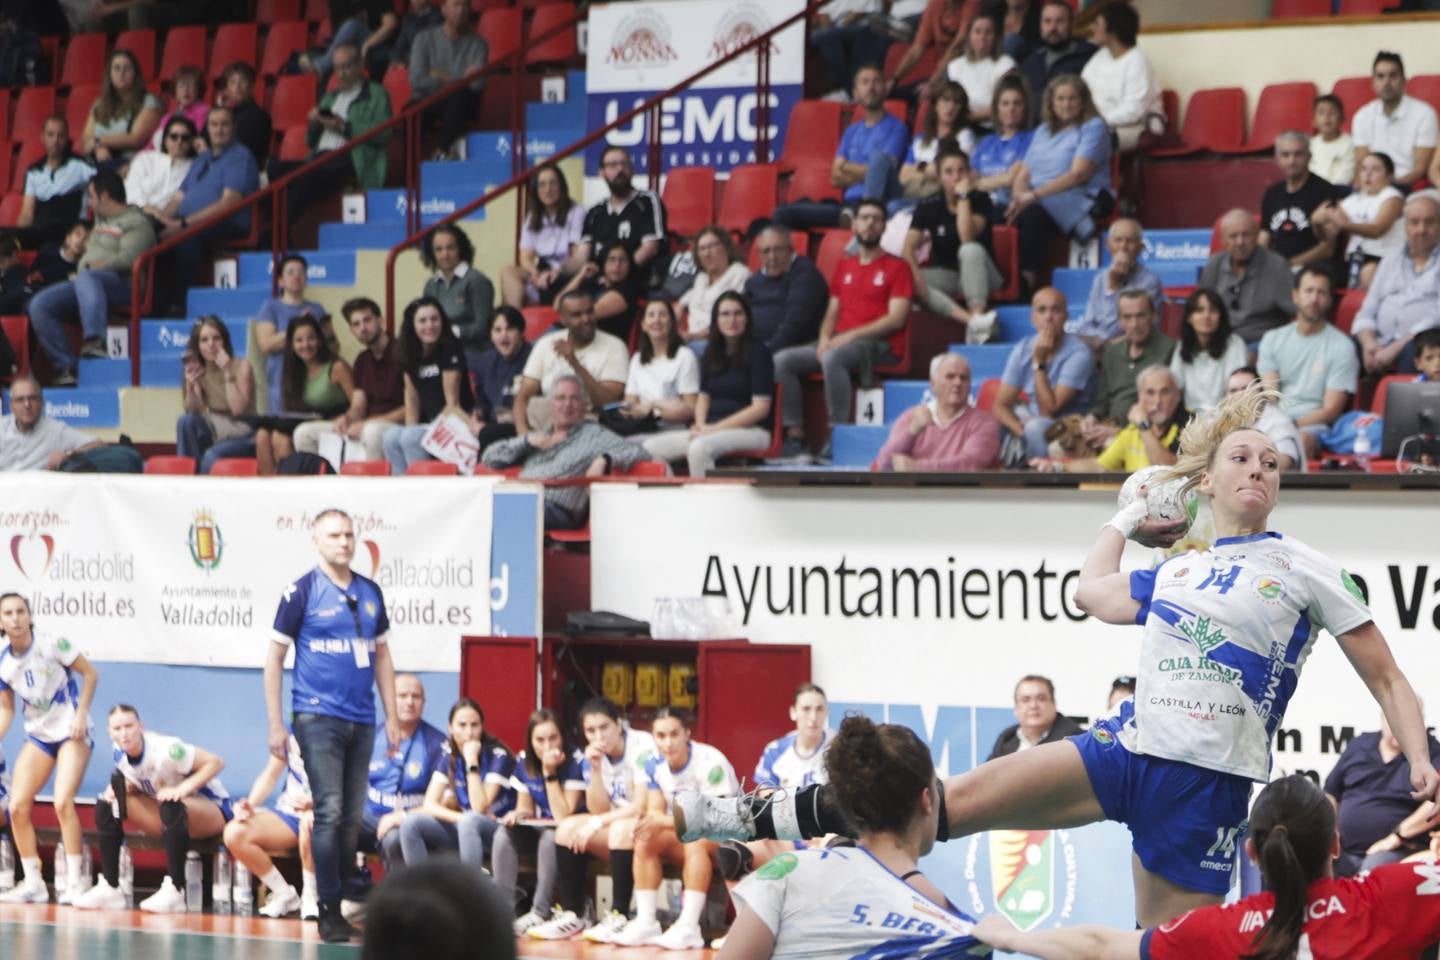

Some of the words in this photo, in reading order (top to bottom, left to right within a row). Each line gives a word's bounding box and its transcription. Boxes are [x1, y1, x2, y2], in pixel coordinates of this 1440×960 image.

[701, 553, 1090, 626] Ayuntamiento
[160, 602, 254, 628] Valladolid
[1158, 656, 1193, 673] CAJA
[1150, 696, 1202, 710] CASTILLA
[1208, 702, 1216, 713] Y
[1219, 703, 1246, 717] LEÓN
